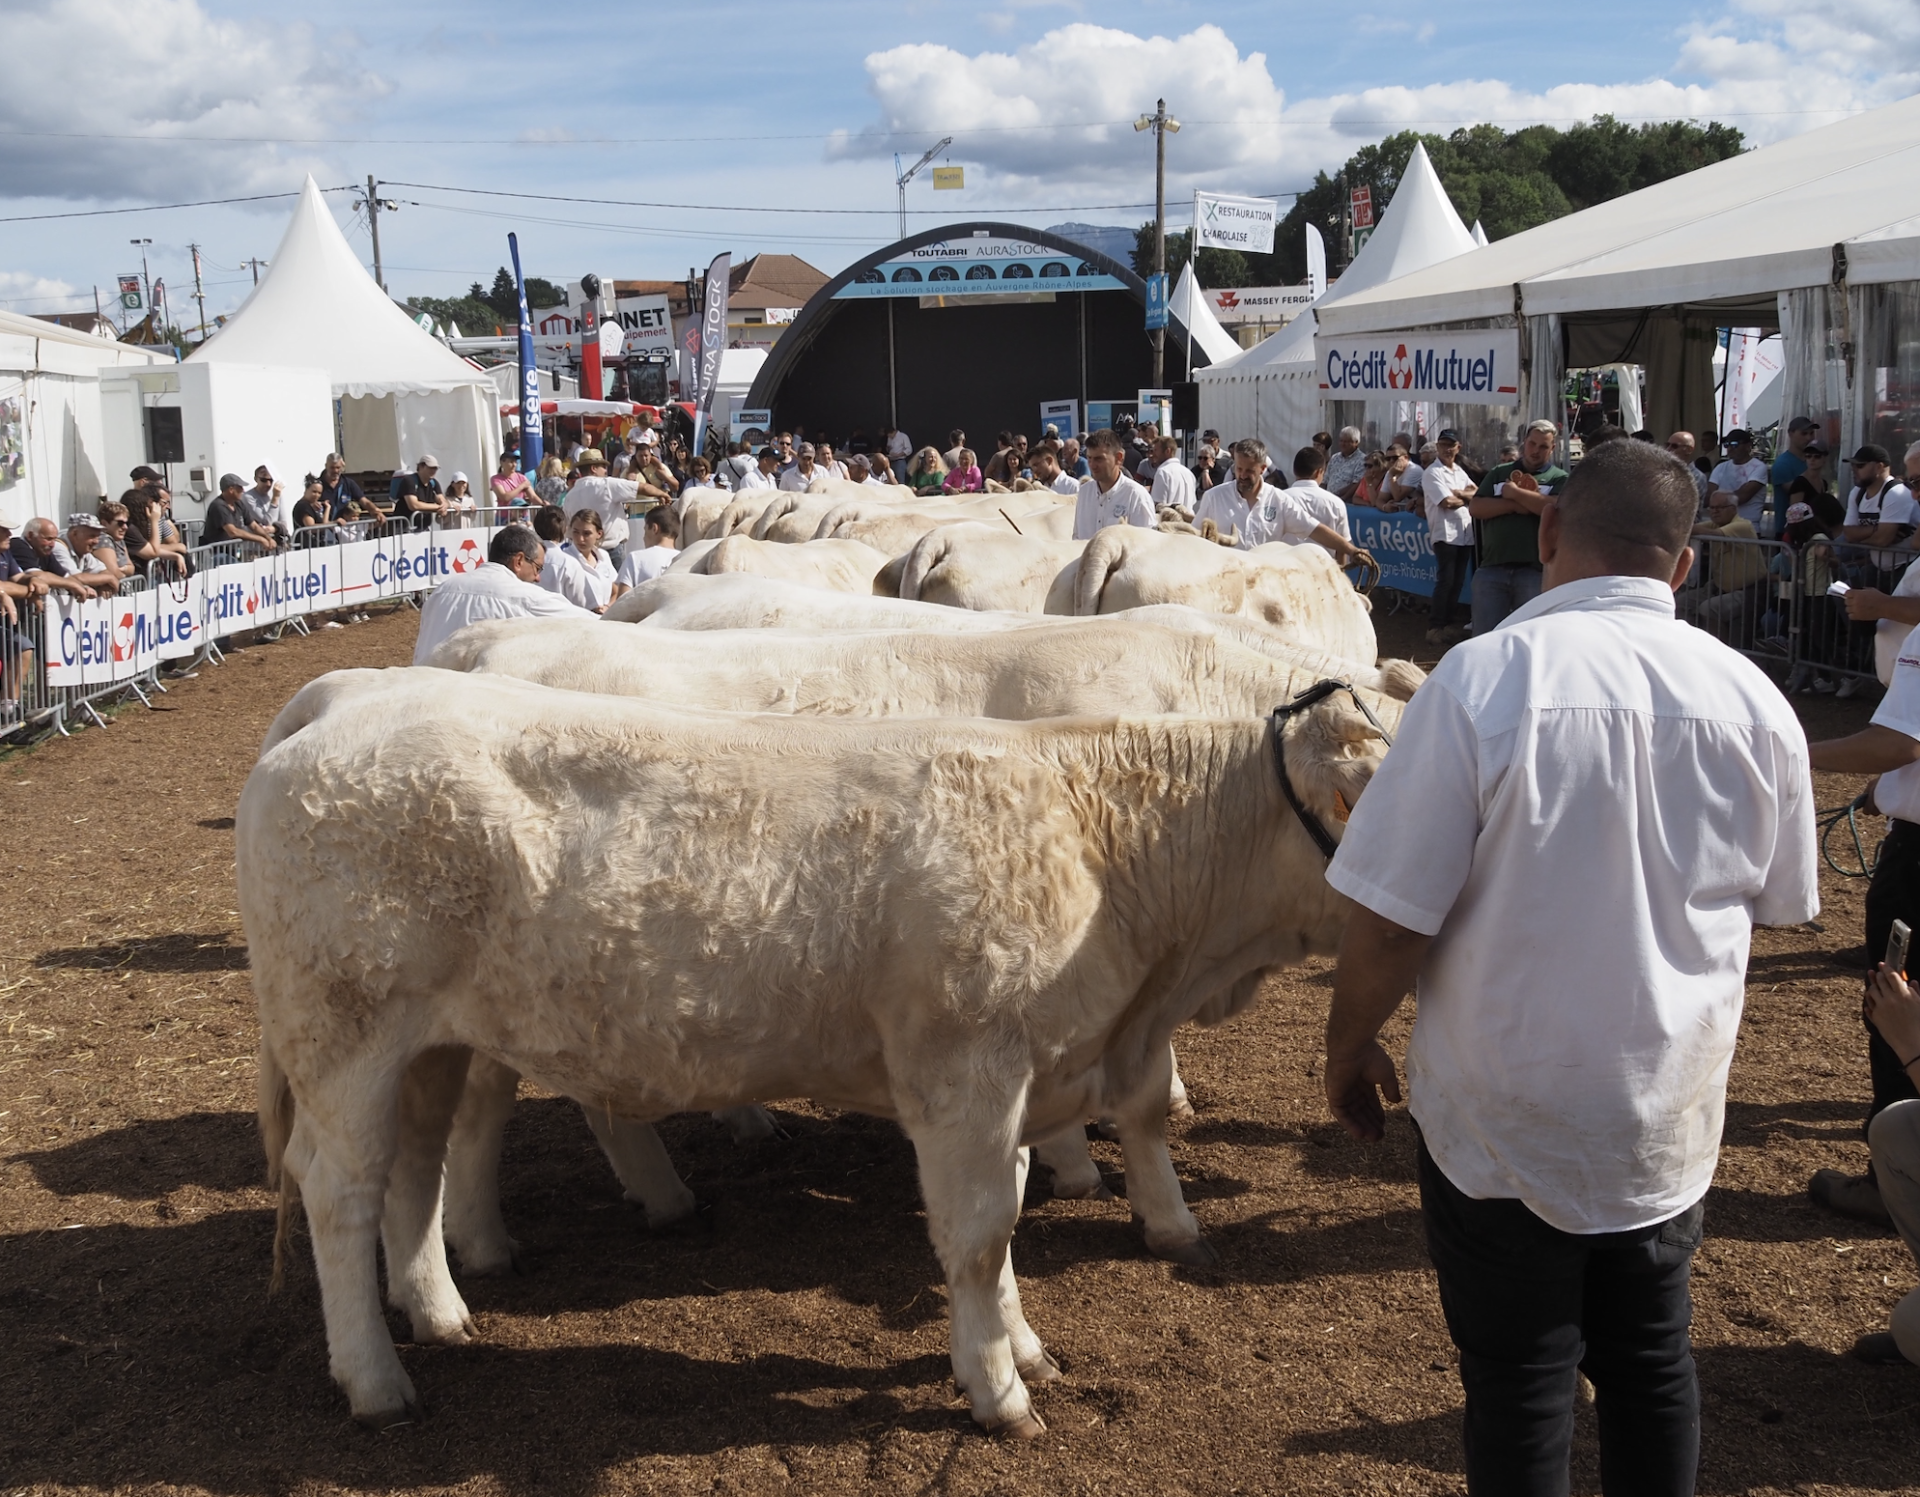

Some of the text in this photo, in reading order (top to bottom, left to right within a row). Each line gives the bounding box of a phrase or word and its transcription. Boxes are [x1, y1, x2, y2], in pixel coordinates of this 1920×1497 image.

[1219, 206, 1272, 221] RESTAURATION
[1202, 228, 1248, 242] CHAROLAISE
[912, 242, 1049, 257] TOUTABRI AURASTOCK
[884, 286, 923, 295] Solution
[926, 285, 966, 293] stockage
[985, 283, 1030, 291] Auvergne
[1032, 280, 1092, 289] Rhône-Alpes
[1244, 295, 1311, 306] MASSEY FERGU
[701, 277, 721, 403] AURASTOCK
[1327, 349, 1494, 392] Crédit Mutuel
[1356, 519, 1435, 561] La Régio
[372, 547, 449, 585] Crédit
[261, 564, 327, 609] Mutuel
